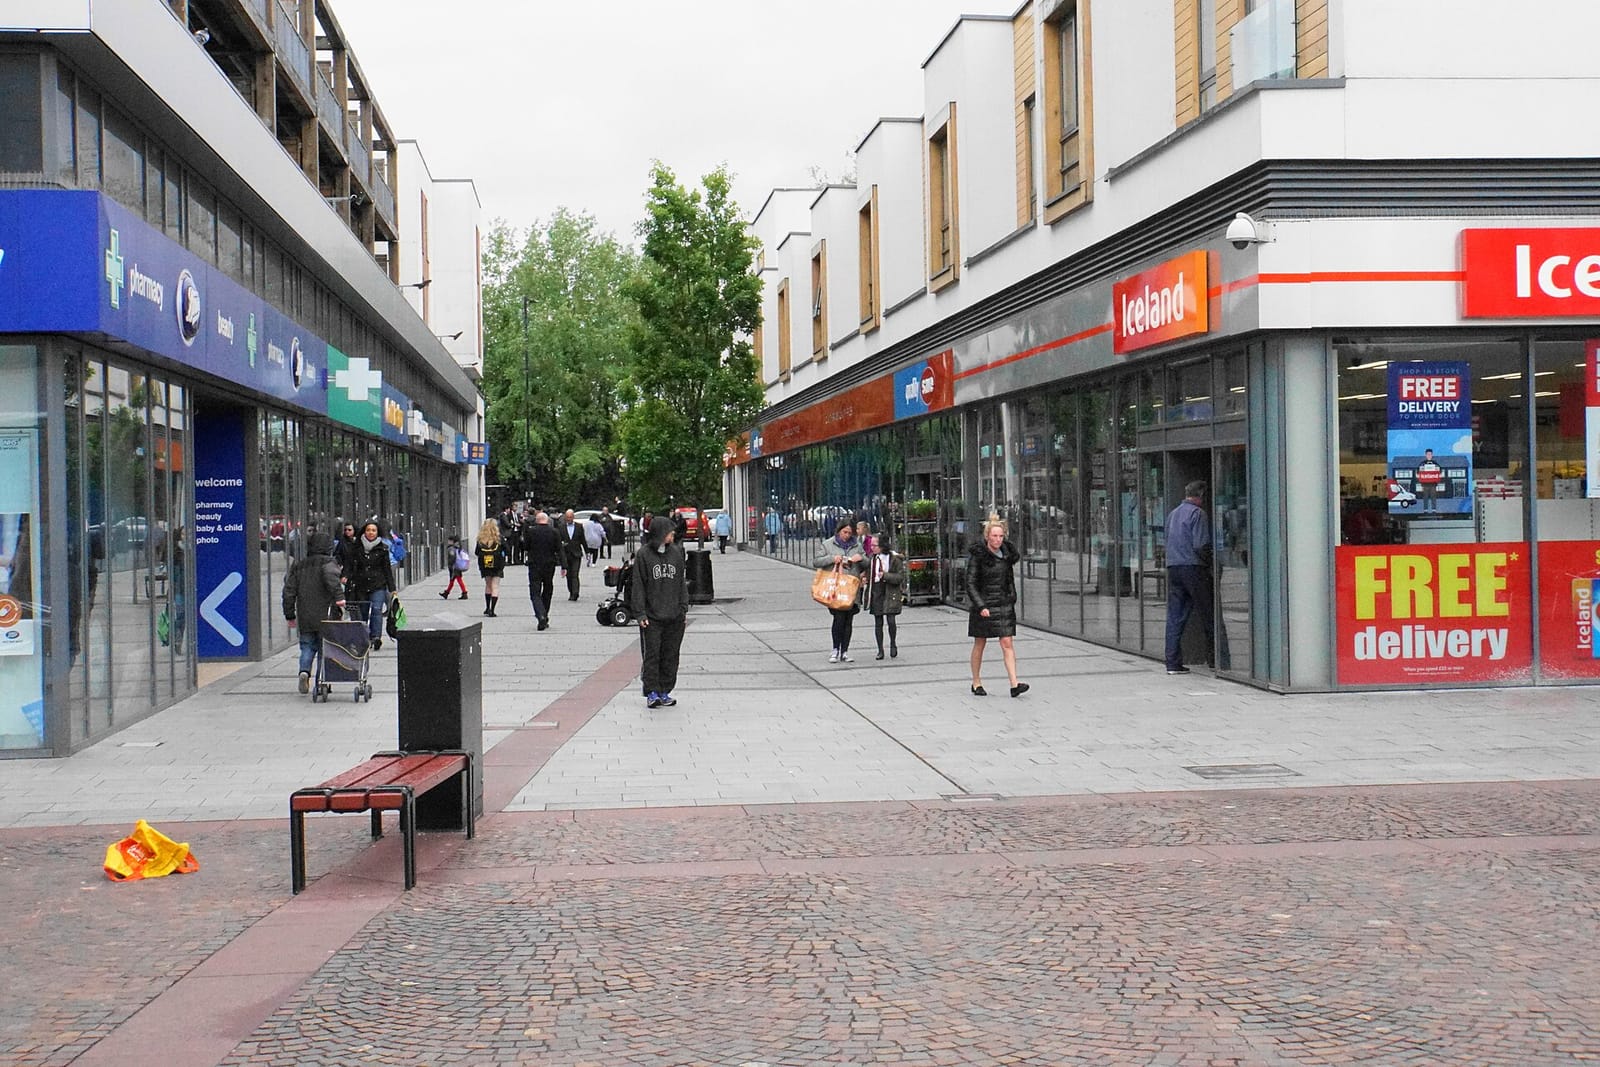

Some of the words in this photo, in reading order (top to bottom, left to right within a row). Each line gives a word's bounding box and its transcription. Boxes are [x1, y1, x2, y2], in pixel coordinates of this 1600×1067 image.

[130, 263, 164, 312] pharmacy
[1122, 271, 1184, 338] Iceland
[1402, 377, 1457, 398] FREE
[1399, 401, 1460, 413] DELIVERY
[195, 478, 243, 487] welcome
[196, 525, 215, 533] baby
[224, 523, 243, 531] child
[1576, 588, 1592, 649] Iceland
[1353, 624, 1509, 660] delivery
